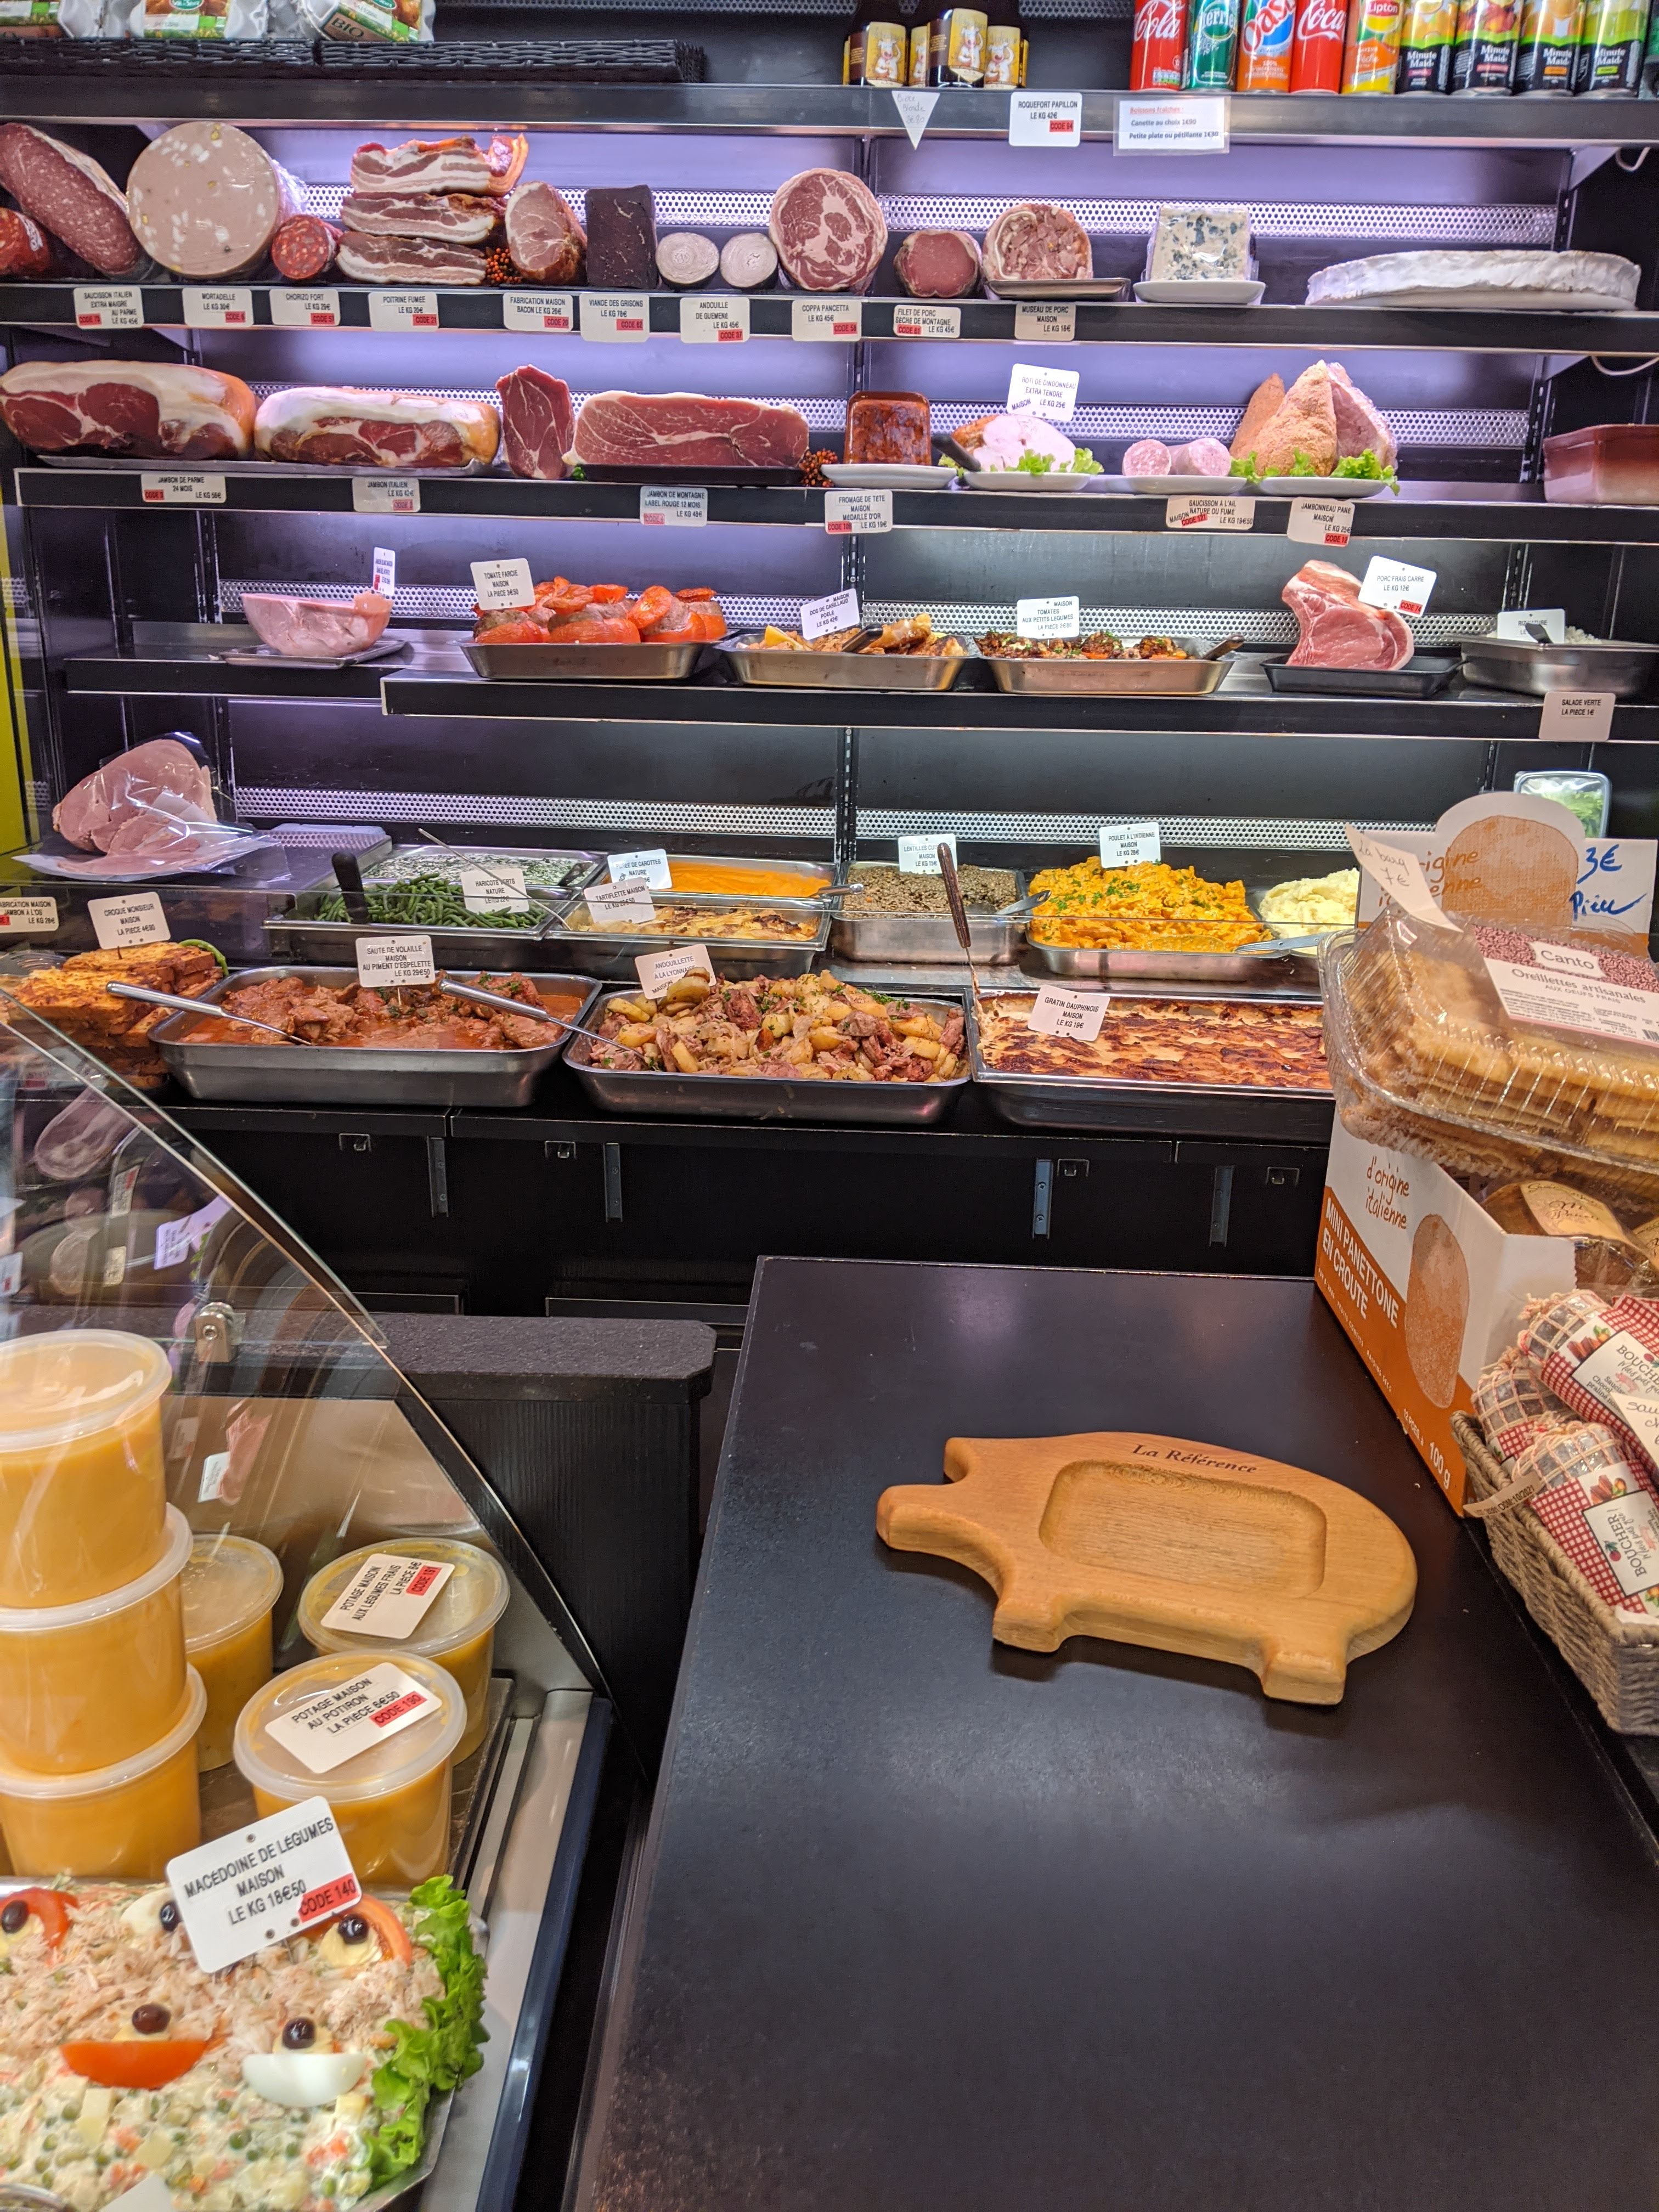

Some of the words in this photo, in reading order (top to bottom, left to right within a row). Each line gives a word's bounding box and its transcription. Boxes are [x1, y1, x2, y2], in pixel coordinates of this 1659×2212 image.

[1368, 2, 1398, 14] Lipton
[331, 17, 364, 38] BIO
[1133, 0, 1183, 42] Cola
[1297, 0, 1346, 40] Coca
[1407, 52, 1436, 61] Minute
[1481, 46, 1510, 55] Minute
[1484, 53, 1508, 62] Maid
[1543, 48, 1572, 58] Minute
[1597, 48, 1625, 58] Minute
[1410, 59, 1434, 67] Maid
[1547, 56, 1570, 65] Maid
[1598, 57, 1622, 65] Maid
[1148, 132, 1163, 140] plate
[1174, 131, 1202, 140] pétillante
[1025, 387, 1041, 395] EXTRA
[1043, 389, 1063, 398] TENDRE
[1012, 398, 1031, 410] MAISON
[1301, 503, 1335, 512] JAMBONNEAU
[1170, 511, 1189, 523] MAISON
[1313, 514, 1334, 522] MAISON
[825, 599, 849, 611] CABILLAUD
[833, 593, 849, 601] MAISON
[1576, 844, 1622, 884] 3€
[596, 890, 627, 901] TARTIFLETTE
[627, 885, 646, 895] MAISON
[104, 907, 127, 917] CROQUE
[127, 903, 155, 914] MONSIEUR
[120, 916, 141, 924] MAISON
[394, 961, 431, 969] D'ESPELETTE
[654, 956, 694, 969] ANDOUILLETTE
[1541, 950, 1594, 969] Canto
[652, 980, 673, 994] MAISON
[1512, 969, 1577, 989] Oreillettes
[1582, 984, 1646, 1003] artisanales
[1545, 985, 1562, 994] AUX
[1565, 988, 1594, 997] OEUFS
[1596, 994, 1621, 1005] FRAIS
[1045, 997, 1065, 1008] GRATIN
[1066, 1002, 1099, 1012] DAUPHINOIS
[1063, 1011, 1082, 1019] MAISON
[1366, 1156, 1409, 1204] d'origine
[1365, 1187, 1407, 1229] italienne
[1325, 1197, 1344, 1243] MINI
[1342, 1227, 1399, 1329] PANETTONE
[1322, 1228, 1333, 1261] EN
[1333, 1249, 1368, 1320] CROUTE
[1367, 1349, 1382, 1376] RAISINS
[1383, 1375, 1392, 1393] SECS
[1131, 1444, 1159, 1458] La
[1165, 1449, 1257, 1474] Référence
[1430, 1441, 1444, 1476] 100
[1444, 1470, 1451, 1489] g
[1607, 1514, 1647, 1577] BOUCHER
[340, 1583, 364, 1611] POTAGE
[361, 1565, 382, 1589] MAISON
[352, 1606, 369, 1621] AUX
[384, 1564, 402, 1584] FRAIS
[291, 1699, 335, 1724] POTAGE
[330, 1678, 373, 1704] MAISON
[307, 1714, 324, 1730] AU
[323, 1694, 369, 1721] POTIRON
[374, 1705, 404, 1724] CODE
[402, 1695, 422, 1708] 190
[184, 1851, 256, 1899] MACÉDOINE
[258, 1843, 275, 1860] DE
[276, 1816, 335, 1856] LÉGUMES
[236, 1864, 285, 1898] MAISON
[229, 1909, 246, 1926] LE
[248, 1900, 267, 1917] KG
[269, 1879, 308, 1909] 18€50
[300, 1888, 335, 1916] CODE
[335, 1878, 357, 1901] 140
